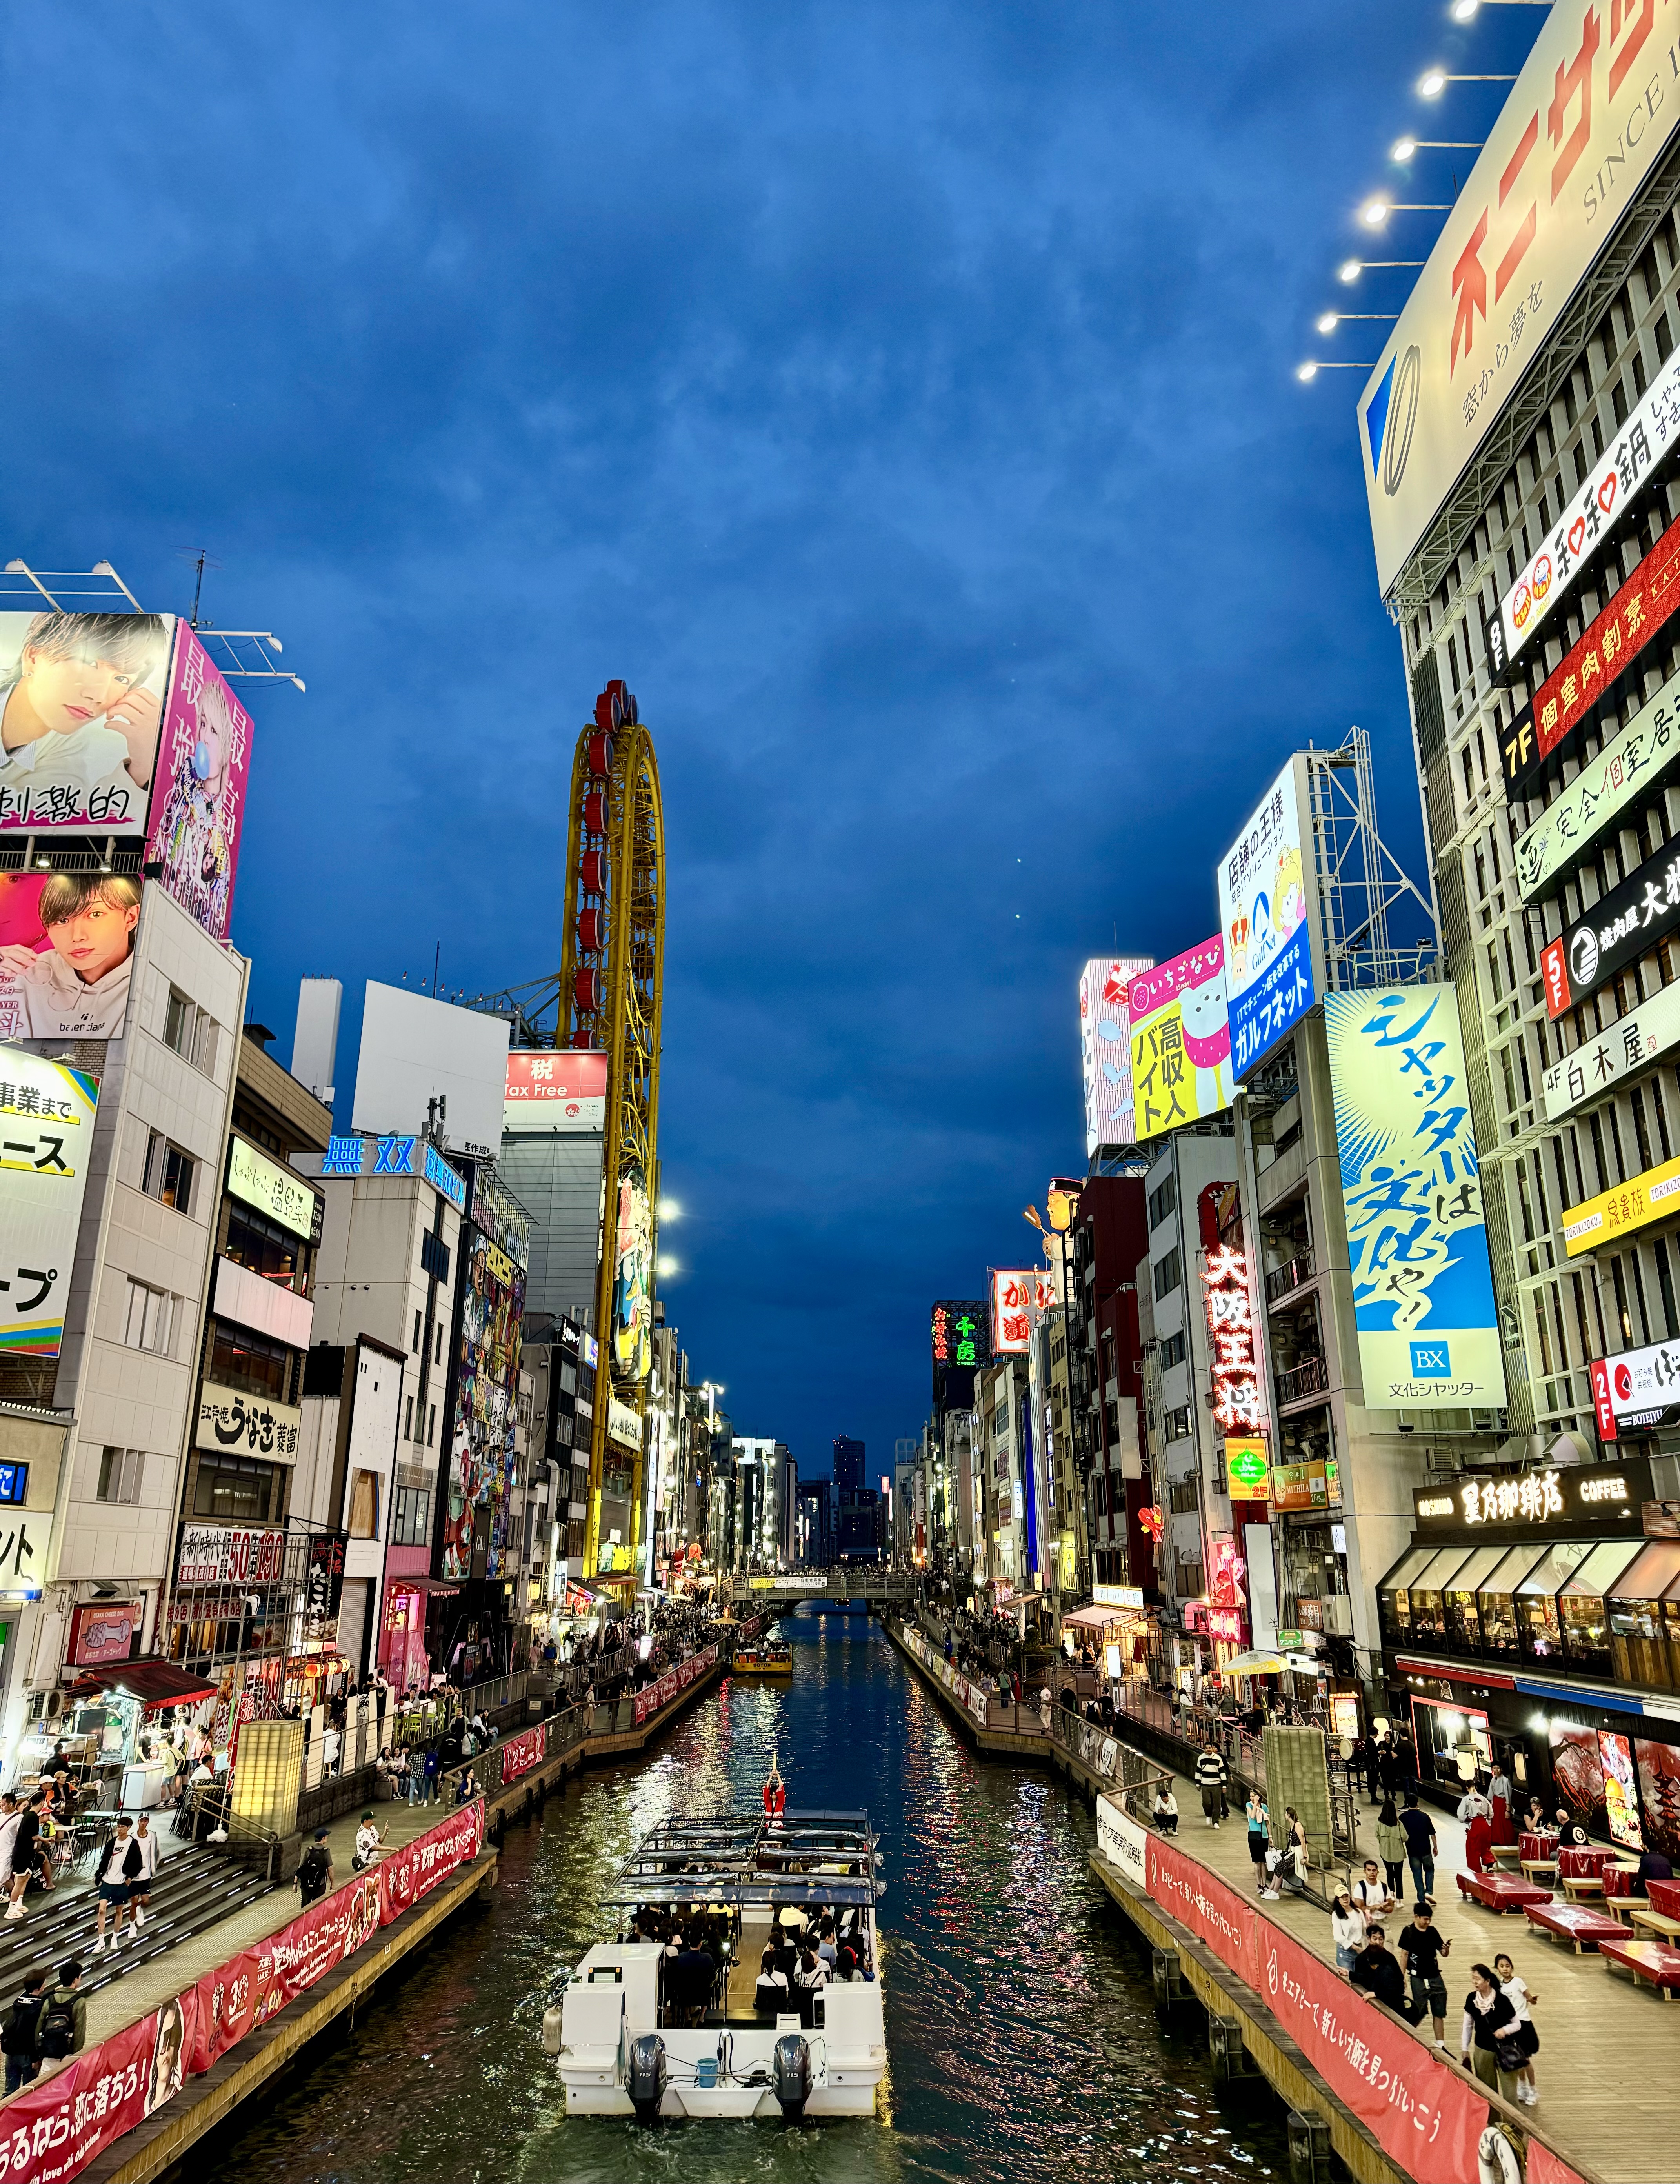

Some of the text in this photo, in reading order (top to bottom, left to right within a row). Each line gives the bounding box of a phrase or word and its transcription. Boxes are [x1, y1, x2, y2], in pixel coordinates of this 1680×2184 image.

[1584, 73, 1667, 224] SINCE
[1464, 280, 1544, 427] 窓から夢を
[1490, 621, 1503, 671] 8F
[1541, 592, 1646, 735] 個室肉割烹
[1505, 721, 1532, 778] 7F
[1556, 695, 1680, 848] 完全個室居
[1229, 787, 1284, 890] 店舗の王様
[1149, 944, 1220, 995] いちごなび
[1175, 978, 1192, 991] 15navi
[1547, 949, 1562, 1008] 5F
[1236, 966, 1308, 1068] ガルフネット
[1137, 1026, 1164, 1133] バイト
[1158, 1015, 1186, 1125] 高収入
[1547, 1067, 1560, 1091] 4F
[1568, 1022, 1646, 1102] 白木屋
[534, 1084, 567, 1096] Free
[322, 1136, 414, 1174] 無双
[1566, 1218, 1599, 1239] TORIKIZOKU
[1608, 1186, 1645, 1229] 鳥貴族
[934, 1308, 948, 1359] お好み焼
[956, 1316, 975, 1360] 千房
[1201, 1244, 1260, 1428] 大阪王将
[1416, 1350, 1447, 1369] BX
[1596, 1373, 1610, 1429] 2F
[1252, 1486, 1267, 1497] 2F
[1286, 1483, 1309, 1494] MITHILA
[1462, 1470, 1562, 1524] 星乃珈琲店
[1580, 1478, 1626, 1502] COFFEE
[228, 1532, 250, 1581] 50
[42, 2163, 62, 2182] love
[64, 2153, 74, 2172] with
